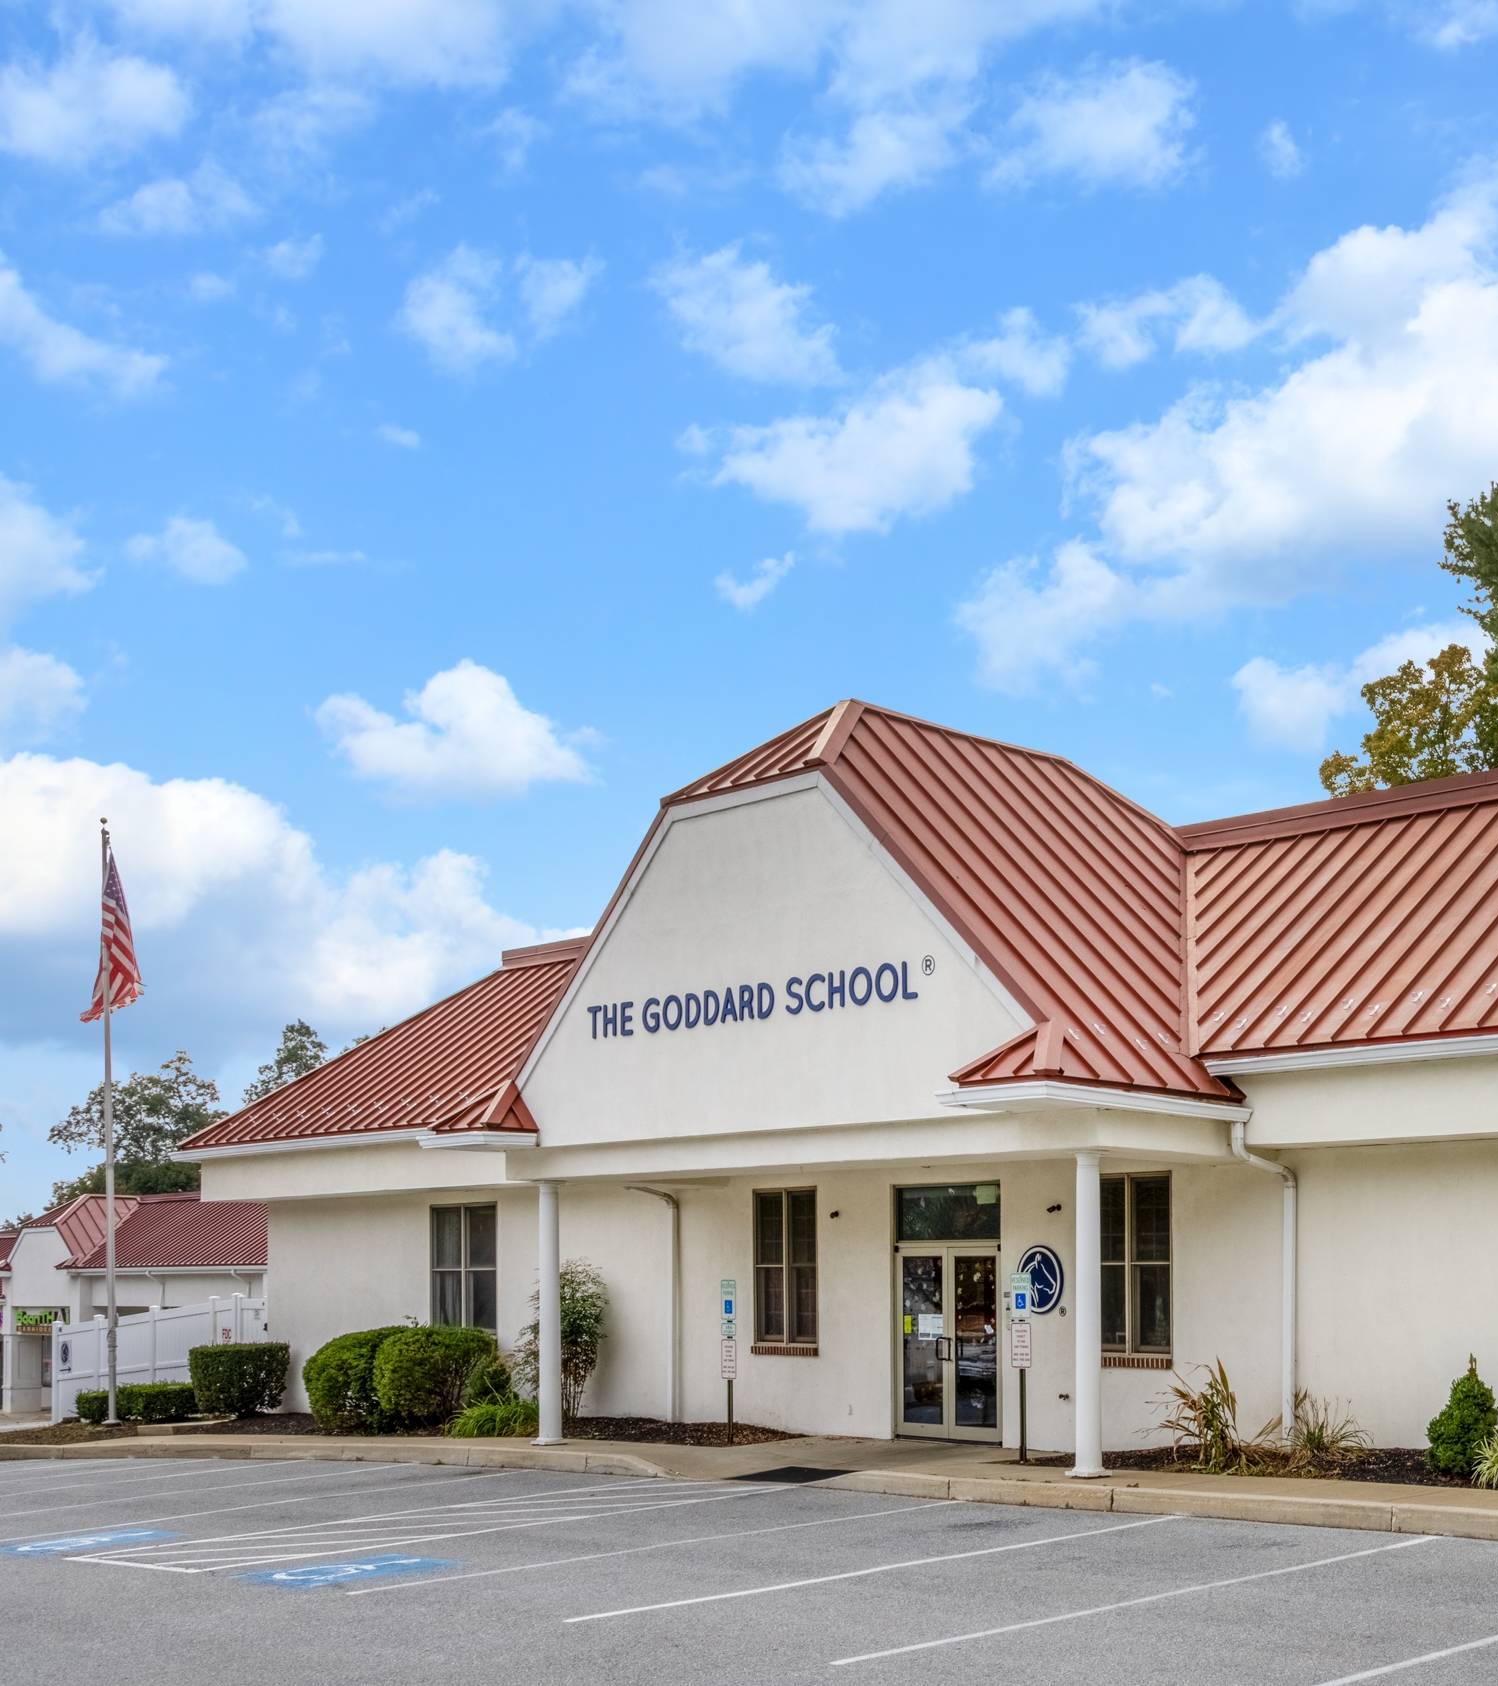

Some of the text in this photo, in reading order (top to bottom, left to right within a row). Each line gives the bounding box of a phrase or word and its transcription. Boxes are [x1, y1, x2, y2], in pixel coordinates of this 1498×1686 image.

[587, 1001, 634, 1039] THE
[642, 982, 775, 1034] GODDARD
[785, 960, 918, 1015] SCHOOL
